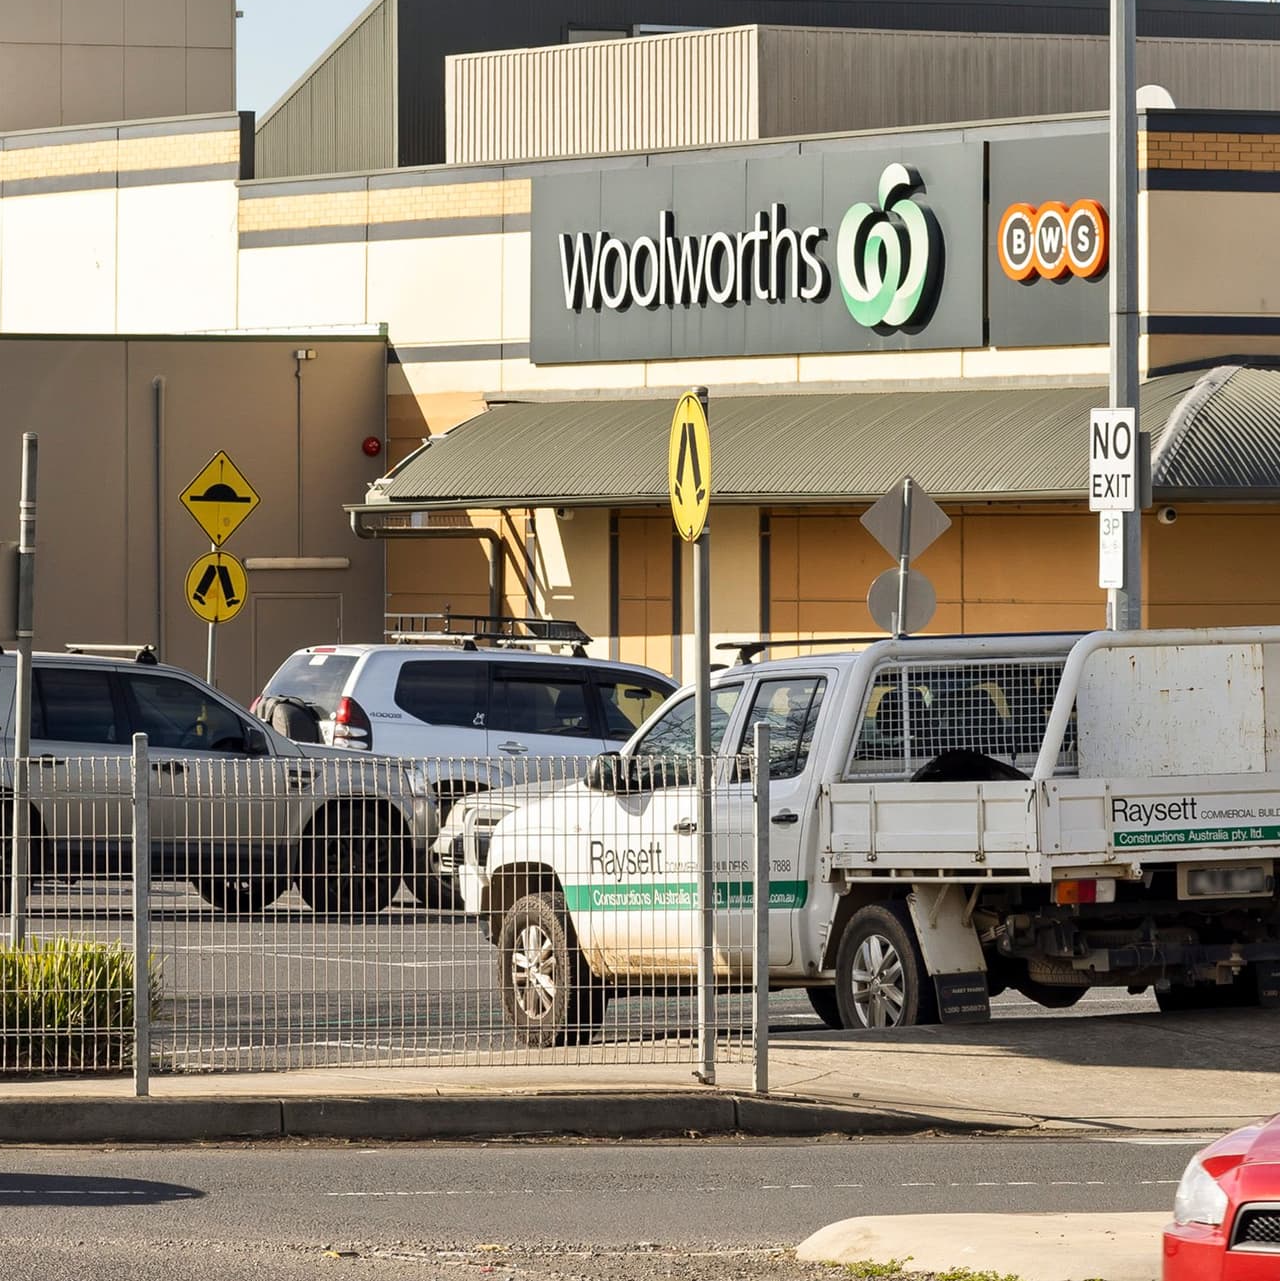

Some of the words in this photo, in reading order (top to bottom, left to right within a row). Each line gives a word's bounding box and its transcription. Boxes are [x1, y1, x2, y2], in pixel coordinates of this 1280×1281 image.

[558, 202, 822, 311] Woolworths
[1093, 421, 1131, 460] NO
[1092, 474, 1131, 498] EXIT
[1103, 518, 1120, 536] 3P
[1112, 797, 1197, 826] Raysett
[1200, 808, 1257, 820] COMMERCIAL
[1119, 832, 1185, 844] Constructions
[1188, 830, 1229, 841] Australia
[1231, 829, 1248, 842] pty.
[1250, 828, 1264, 839] ltd.
[590, 840, 663, 883] Raysett
[773, 859, 792, 872] 7888
[593, 889, 652, 907] Constructions
[654, 888, 691, 906] Australia
